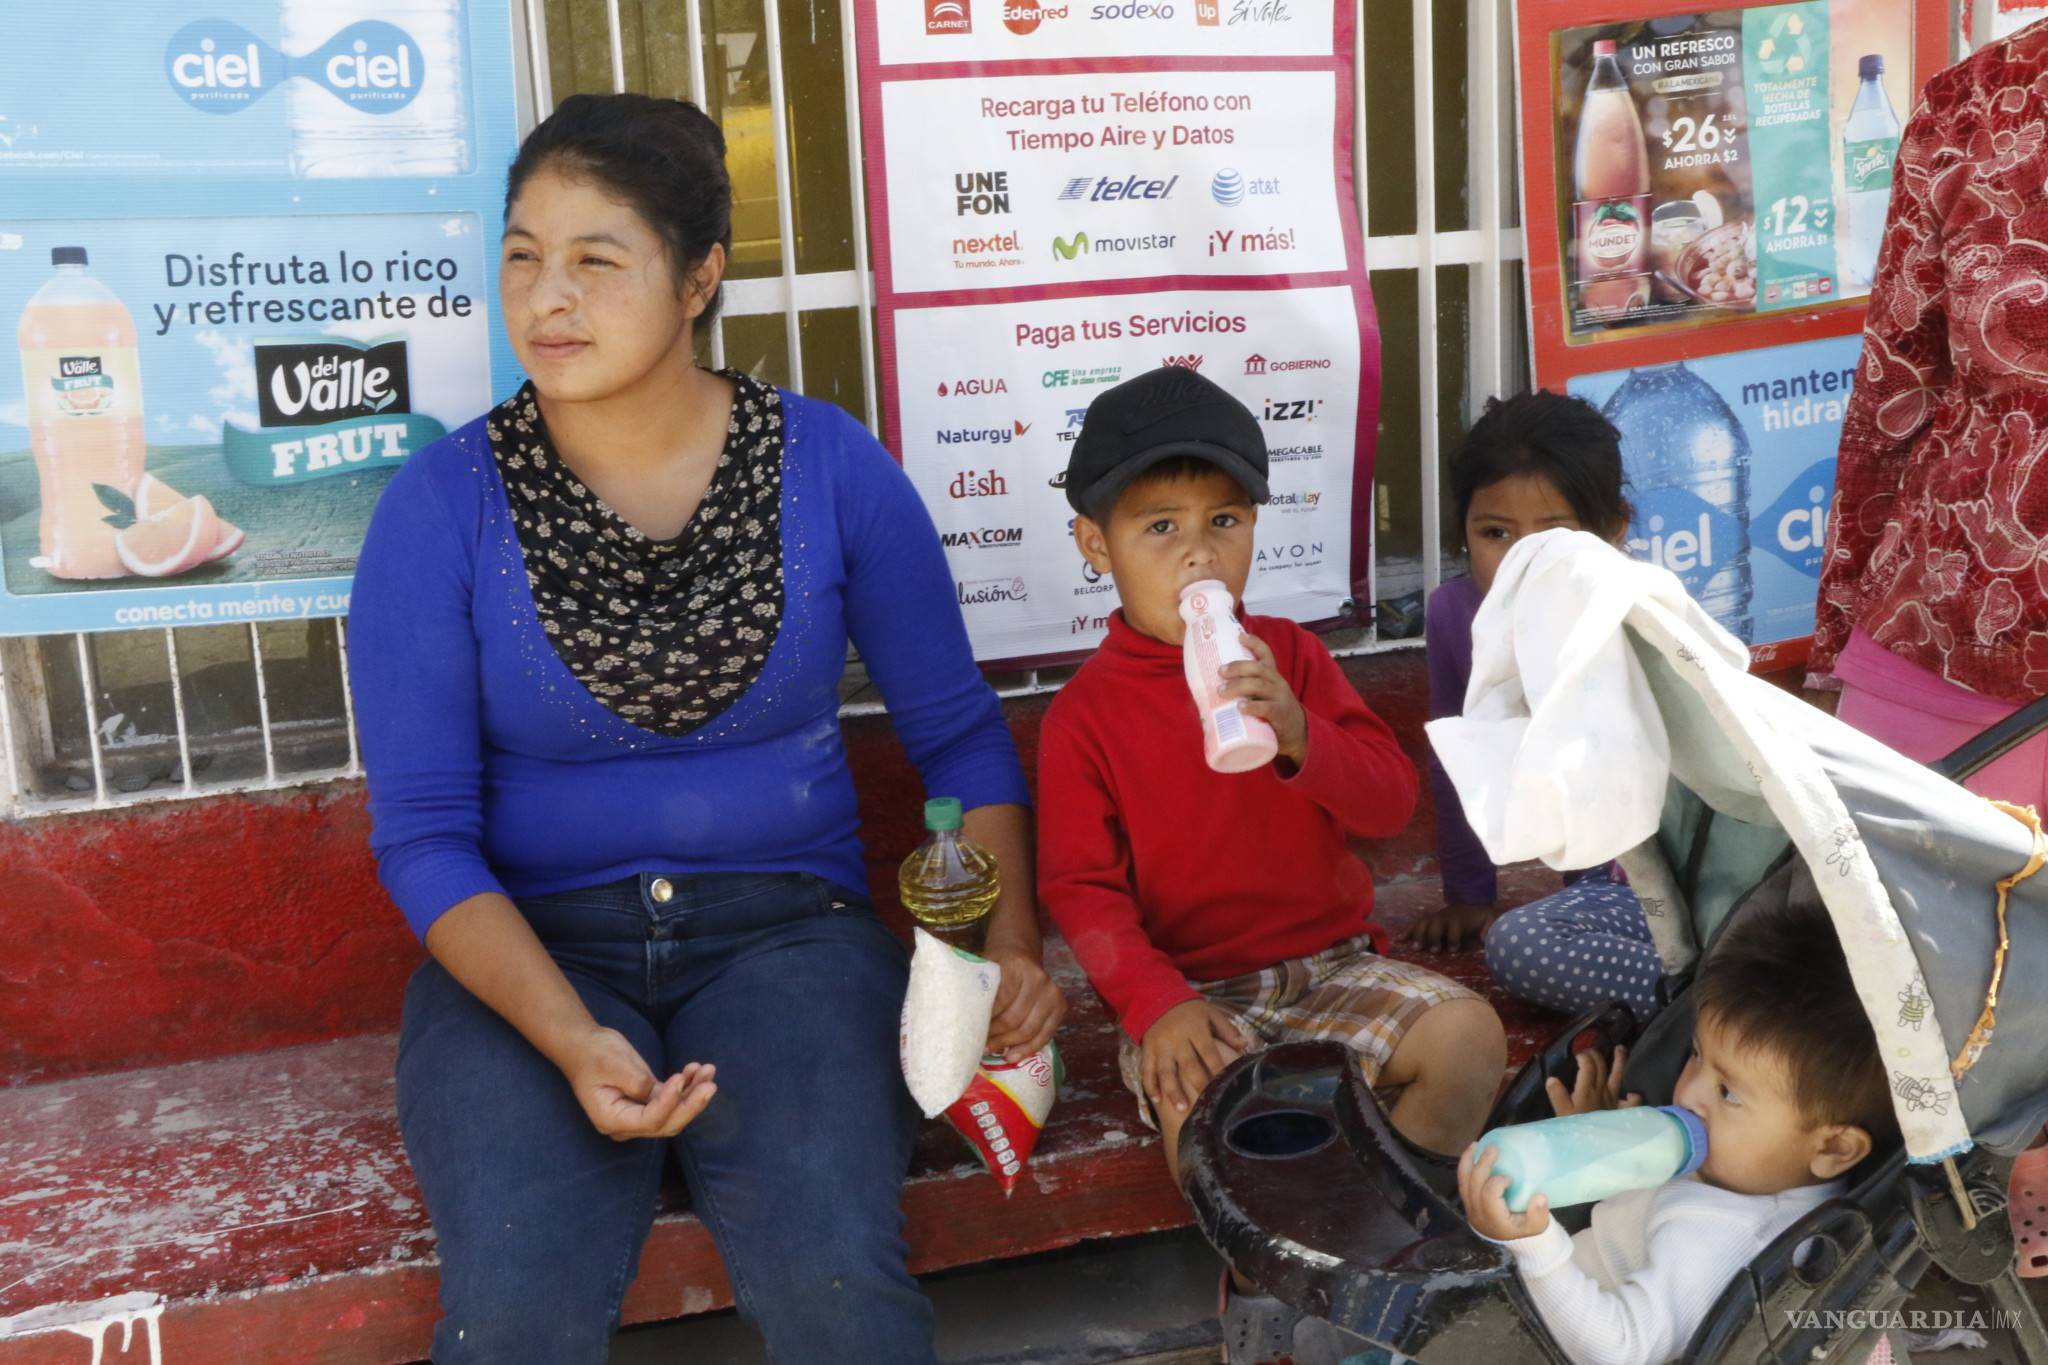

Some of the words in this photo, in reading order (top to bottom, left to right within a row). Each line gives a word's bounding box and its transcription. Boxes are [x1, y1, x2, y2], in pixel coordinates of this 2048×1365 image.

[1003, 4, 1069, 21] Edenred
[1090, 0, 1174, 20] sodexo
[1199, 3, 1216, 20] Up
[928, 20, 969, 29] CARNET
[1632, 45, 1656, 60] UN
[1660, 36, 1735, 57] REFRESCO
[173, 38, 261, 88] ciel
[326, 39, 411, 89] ciel
[1633, 62, 1662, 75] CON
[1664, 57, 1699, 72] GRAN
[1701, 52, 1736, 67] SABOR
[1754, 76, 1817, 93] TOTALMENTE
[981, 97, 1076, 119] Recarga
[1082, 96, 1105, 114] tu
[1110, 91, 1209, 114] Teléfono
[1214, 93, 1251, 111] con
[1763, 90, 1795, 104] HECHA
[1797, 88, 1809, 101] DE
[1755, 109, 1822, 127] RECUPERADAS
[1764, 100, 1810, 115] BOTELLAS
[1006, 128, 1094, 152] Tiempo
[1100, 127, 1147, 147] Aire
[1153, 129, 1166, 150] y
[1173, 125, 1235, 146] Datos
[1664, 152, 1721, 170] AHORRA
[1723, 149, 1739, 164] $2
[955, 171, 1008, 194] UNE
[1090, 175, 1179, 202] telcel
[1248, 177, 1281, 195] at&t
[957, 194, 1011, 216] FON
[953, 231, 1020, 255] nextel
[1095, 233, 1177, 252] movistar
[1208, 230, 1234, 257] ¡Y
[1241, 228, 1297, 253] más!
[1588, 233, 1637, 249] MUNDET
[1765, 235, 1816, 253] AHORRA
[165, 252, 329, 287] Disfruta
[340, 251, 373, 284] lo
[386, 250, 458, 282] rico
[153, 303, 176, 336] y
[188, 290, 417, 325] refrescante
[428, 285, 472, 319] de
[1016, 323, 1076, 349] Paga
[1081, 319, 1122, 341] tus
[1129, 310, 1247, 337] Servicios
[311, 355, 338, 379] del
[1270, 359, 1331, 372] GOBIERNO
[271, 358, 390, 416] Valle
[954, 378, 1008, 396] AGUA
[1042, 369, 1070, 388] CFE
[1741, 368, 1856, 405] manten
[937, 427, 1012, 445] Naturgy
[270, 424, 408, 478] FRUT
[949, 469, 1008, 499] dish
[1777, 485, 1831, 553] ci
[941, 527, 1023, 548] MAXCOM
[1256, 542, 1324, 562] AVON
[1074, 584, 1114, 596] BELCORP
[115, 600, 212, 623] conecta
[219, 594, 295, 617] mente
[298, 595, 312, 616] y
[1072, 616, 1087, 634] ¡Y
